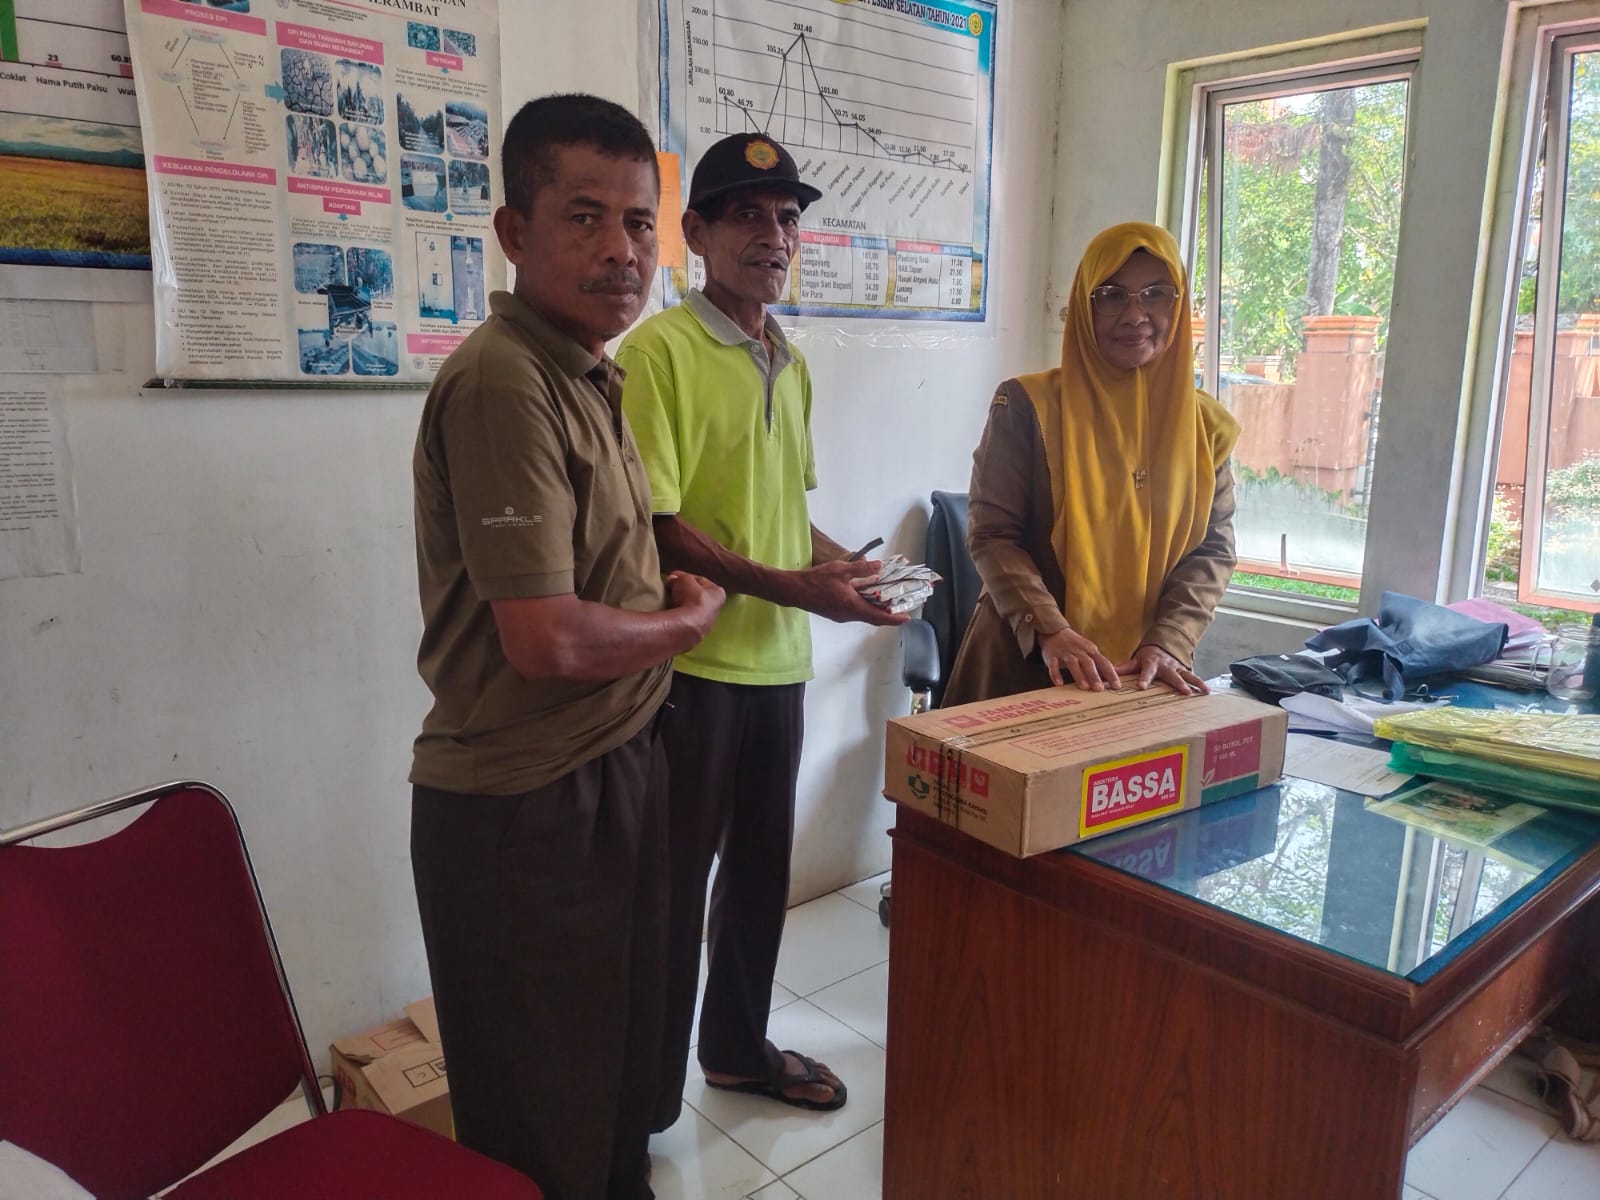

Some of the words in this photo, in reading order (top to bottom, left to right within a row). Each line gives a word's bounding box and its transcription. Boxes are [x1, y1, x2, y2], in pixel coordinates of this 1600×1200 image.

[368, 0, 440, 16] RAMBAT
[691, 6, 708, 16] 200.00
[896, 2, 926, 18] SELATAN
[927, 8, 950, 24] TAHUN
[950, 14, 967, 28] 2021
[793, 22, 812, 32] 202.40
[767, 44, 784, 54] 155.25
[36, 76, 61, 86] Hama
[63, 80, 85, 90] Putih
[86, 83, 108, 93] Palsu
[820, 86, 838, 95] 101.00
[718, 87, 734, 97] 60.80
[823, 218, 866, 230] KECAMATAN
[482, 515, 542, 526] SPARKLE
[977, 700, 1045, 718] JANGAN
[986, 699, 1082, 723] DIBANTING
[1092, 768, 1176, 813] BASSA
